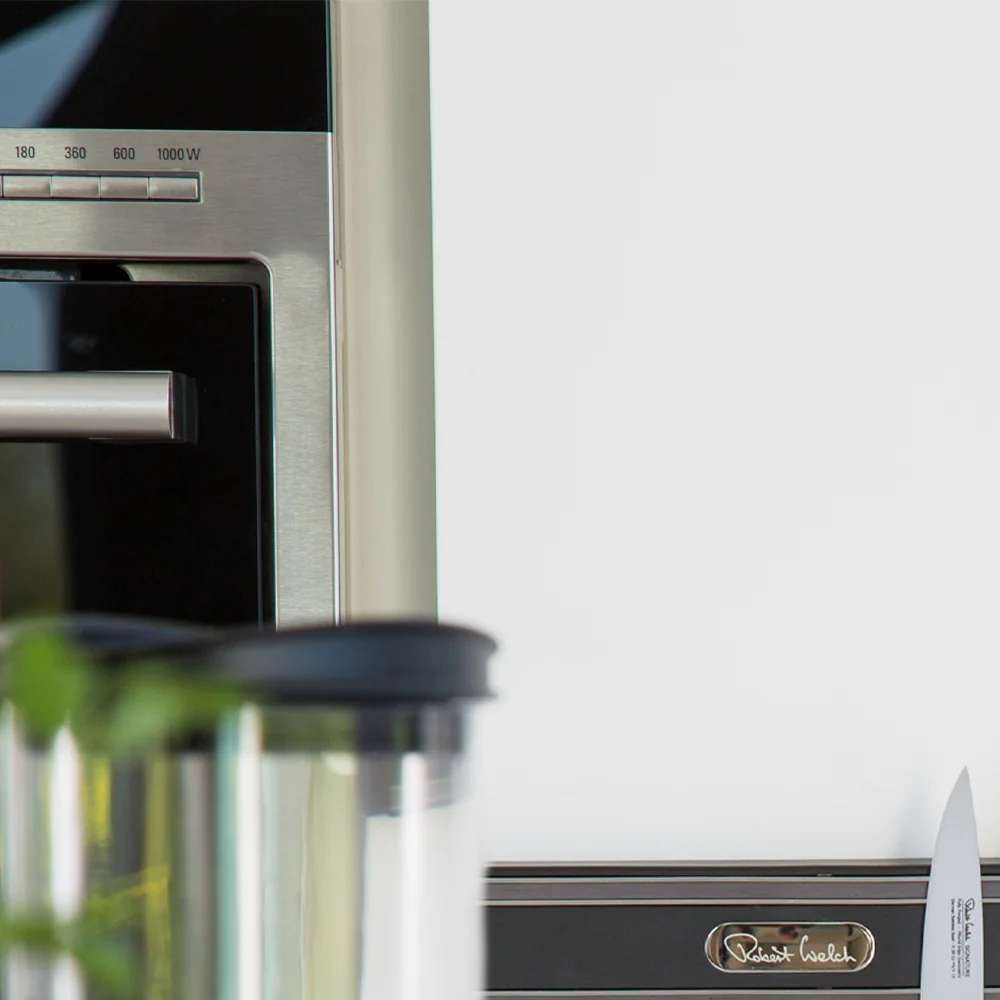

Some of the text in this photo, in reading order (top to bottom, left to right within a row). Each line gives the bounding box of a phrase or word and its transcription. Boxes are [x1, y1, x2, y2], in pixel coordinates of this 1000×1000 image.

[15, 146, 35, 159] 180
[64, 146, 86, 160] 360
[113, 148, 135, 160] 600
[724, 932, 857, 963] Robert Welch
